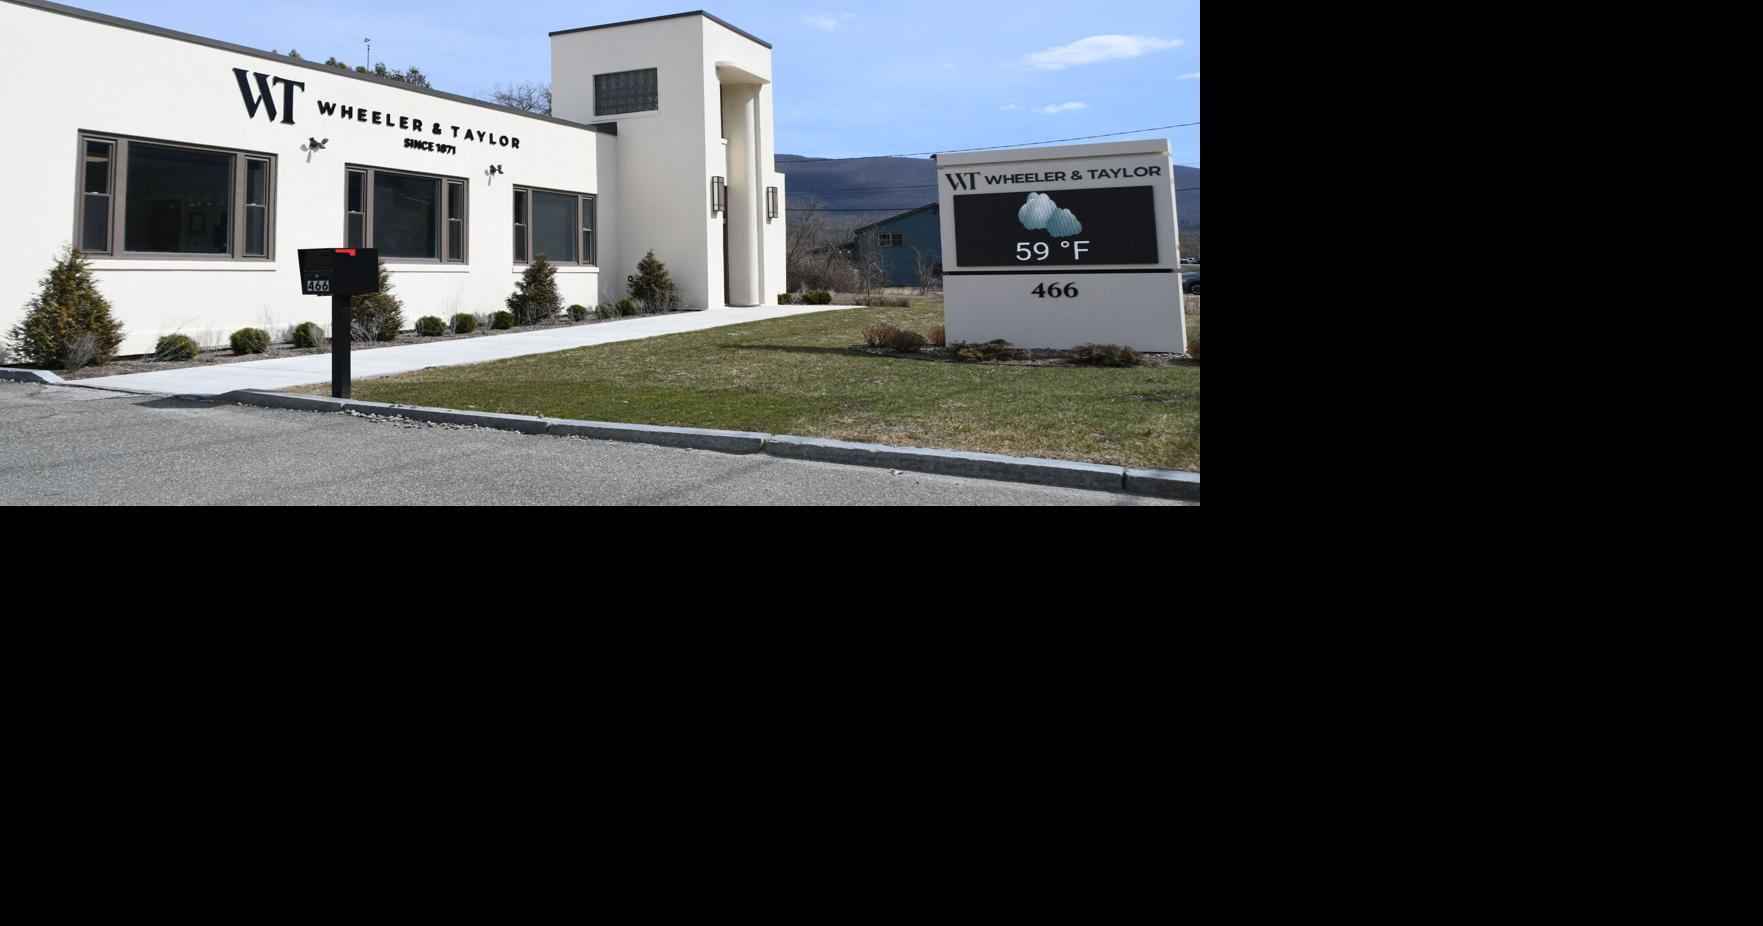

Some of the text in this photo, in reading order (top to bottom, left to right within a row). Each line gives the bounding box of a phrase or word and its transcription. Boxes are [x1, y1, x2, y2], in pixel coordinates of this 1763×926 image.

[232, 67, 305, 125] WT
[317, 100, 520, 149] WHEELER & TAYLOR
[404, 137, 434, 151] SINCE
[944, 166, 1161, 191] WT WHEELER & TAYLOR
[1016, 240, 1090, 261] 59 °F
[308, 280, 329, 291] 466
[1031, 282, 1079, 299] 466
